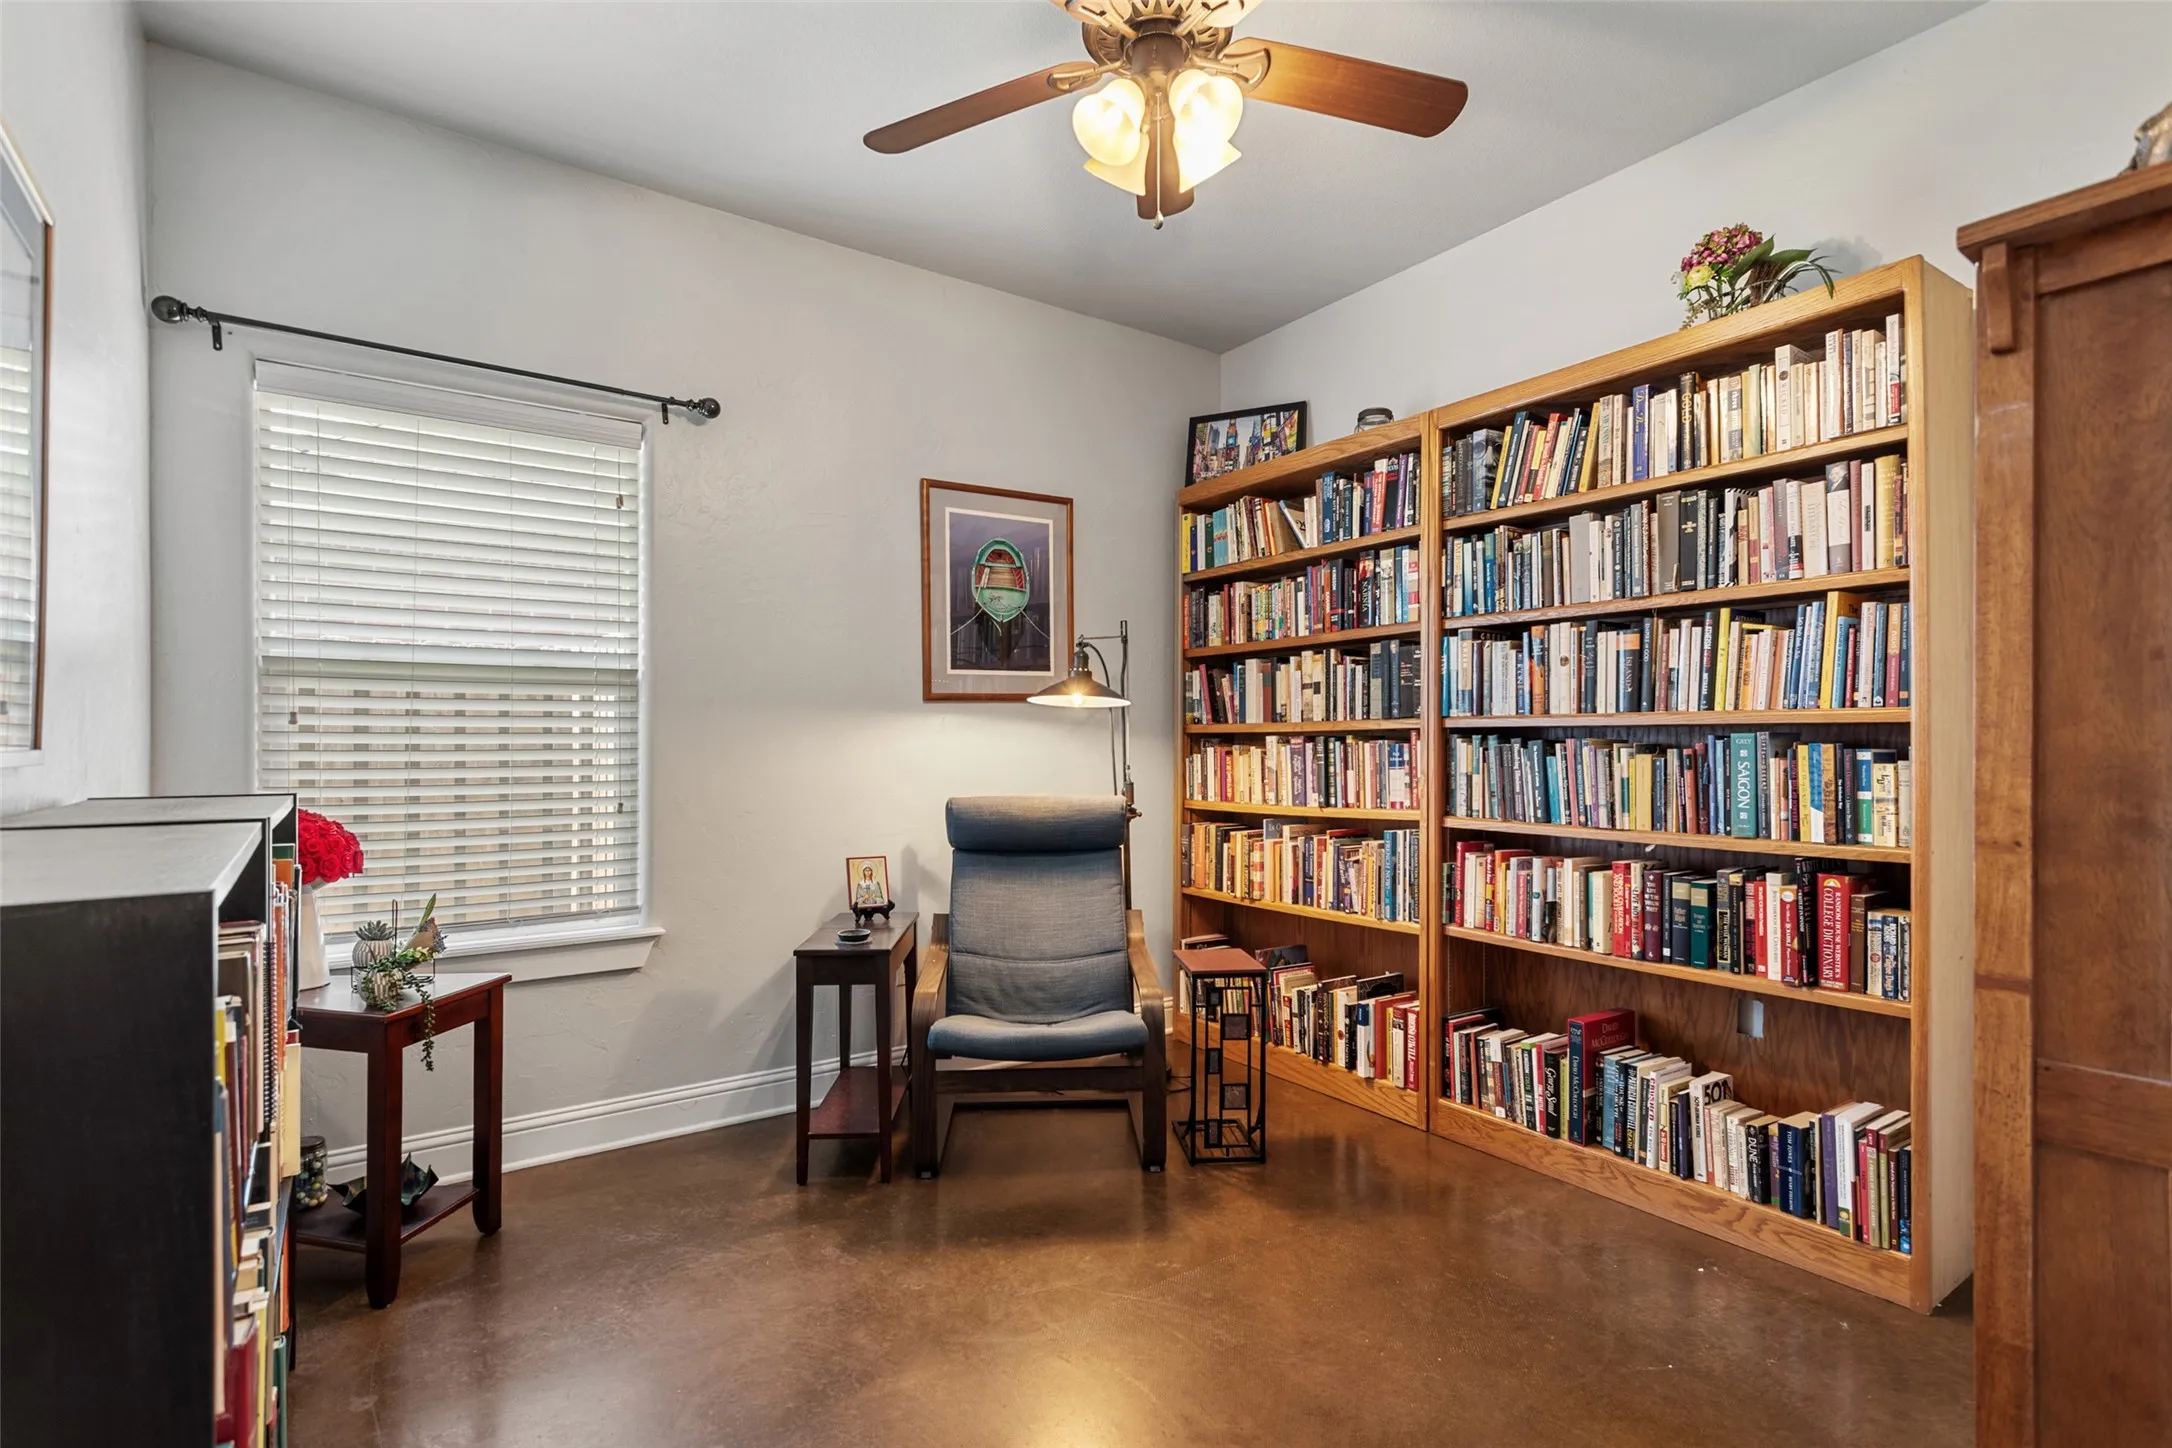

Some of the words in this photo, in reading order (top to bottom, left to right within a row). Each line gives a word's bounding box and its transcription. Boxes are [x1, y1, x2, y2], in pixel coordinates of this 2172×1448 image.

[1682, 393, 1692, 423] GOLD
[1807, 503, 1816, 550] LITERATURE
[1625, 656, 1633, 688] ISLAND
[1513, 743, 1521, 769] Dissolving
[1737, 761, 1750, 808] SAIGON
[1823, 888, 1834, 926] COLLEGE
[1633, 921, 1639, 931] BY
[1823, 928, 1834, 980] DICTIONARY
[1545, 1067, 1557, 1091] George
[1628, 1076, 1636, 1100] PATRICIA
[1546, 1091, 1557, 1116] Sand
[1626, 1101, 1635, 1129] CORNWELL
[1626, 1129, 1634, 1149] DEATH
[1748, 1137, 1758, 1163] DUNE
